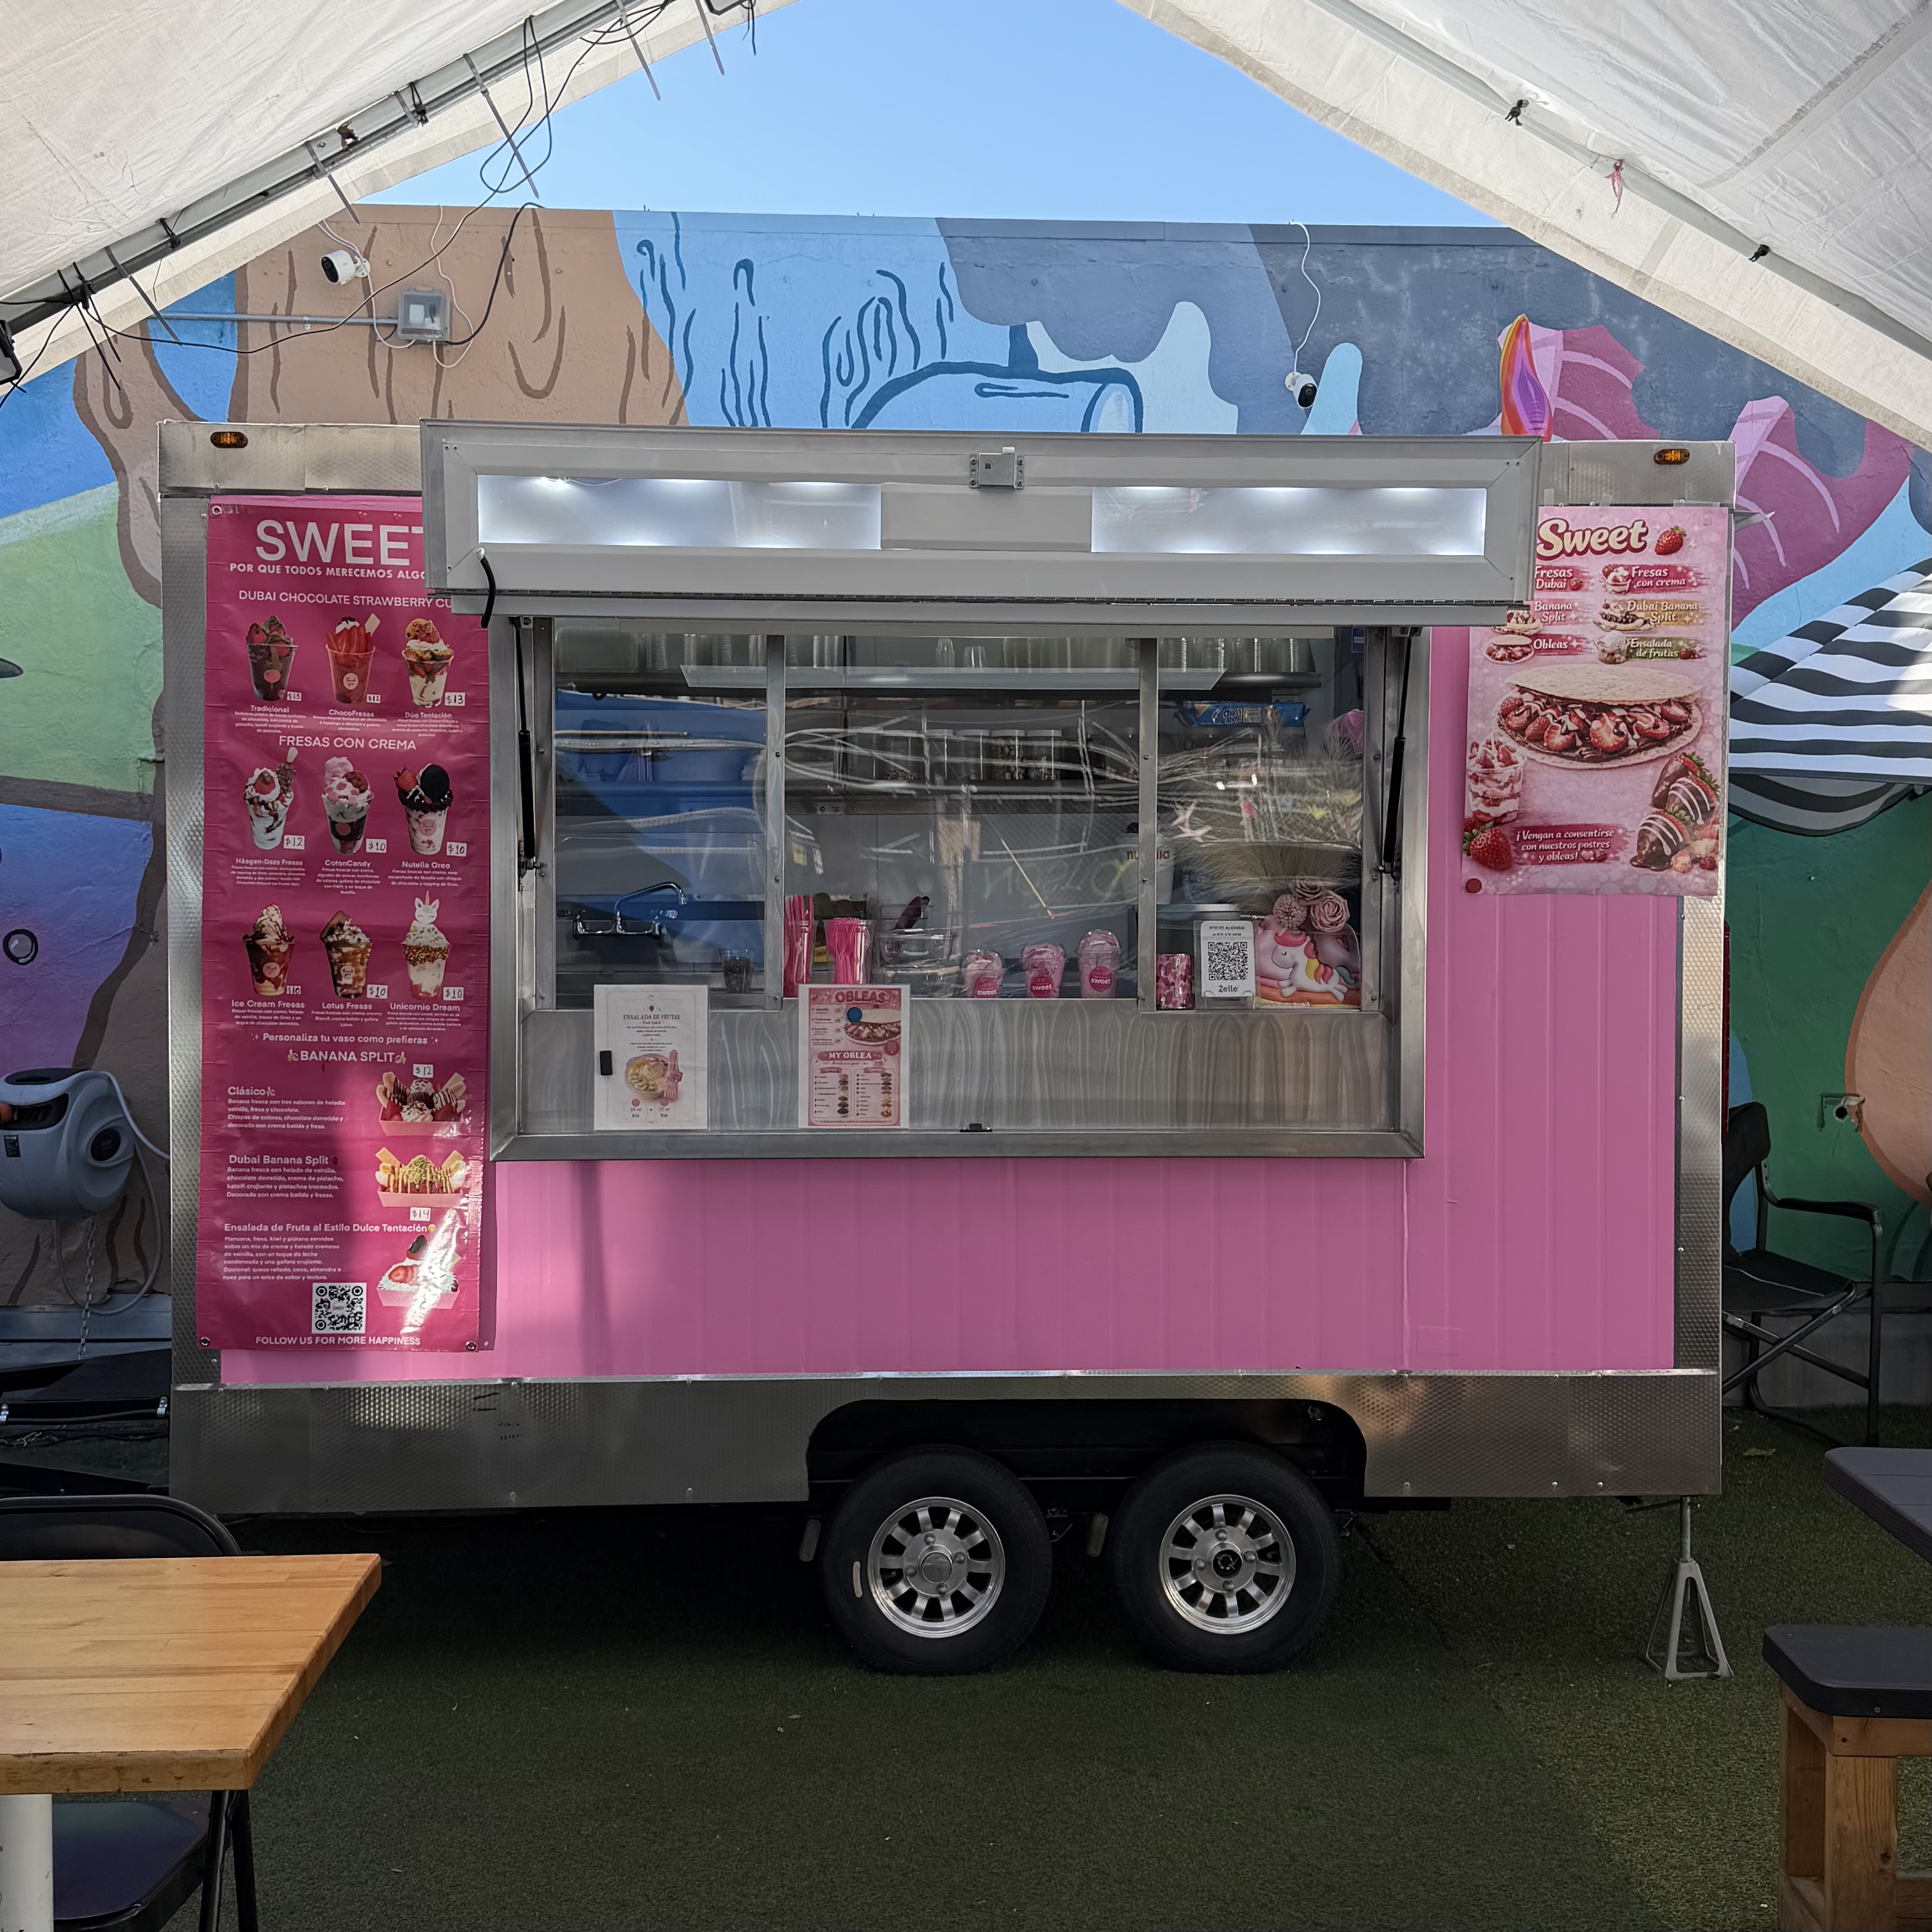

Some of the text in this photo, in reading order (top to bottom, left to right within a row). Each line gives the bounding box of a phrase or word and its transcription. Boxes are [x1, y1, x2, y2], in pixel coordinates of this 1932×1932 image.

[1537, 518, 1648, 560] Sweet
[230, 563, 253, 572] POR
[258, 565, 281, 573] QUE
[285, 566, 322, 575] TODOS
[326, 567, 393, 578] MERECEMOS
[1535, 566, 1573, 578] Fresas
[1632, 566, 1668, 578] Fresas
[1536, 579, 1566, 589] Dubai
[239, 591, 276, 601] DUBAI
[279, 592, 350, 604] CHOCOLATE
[353, 595, 433, 607] STRAWBERRY
[1534, 601, 1572, 611] Banana
[1627, 601, 1698, 611] Dubai Banana
[1541, 612, 1566, 624] Split
[1650, 612, 1676, 624] Split
[1534, 639, 1568, 649] Obleas
[1630, 638, 1672, 647] Ensalada
[1650, 649, 1678, 658] frutas
[446, 695, 463, 704] $13
[329, 709, 374, 717] ChocoFresas
[279, 736, 416, 750] FRESAS CON CREMA
[1523, 830, 1553, 841] Vengan
[1565, 829, 1614, 838] consentirse
[285, 837, 302, 846] $12
[369, 842, 385, 851] $10
[1578, 841, 1610, 851] postres
[448, 843, 465, 854] $10
[1538, 852, 1578, 863] y obleas!
[369, 986, 386, 997] $10
[446, 989, 462, 998] $10
[835, 990, 887, 1004] OBLEAS
[263, 1033, 318, 1042] Personaliza
[386, 1036, 428, 1044] prefieras
[301, 1050, 395, 1062] BANANA SPLIT
[415, 1067, 432, 1075] $12
[228, 1086, 265, 1095] Clásico
[229, 1155, 328, 1166] Dubai Banana Split
[412, 1209, 429, 1218] $14
[353, 1224, 380, 1232] Dulce
[382, 1224, 427, 1232] Tentación
